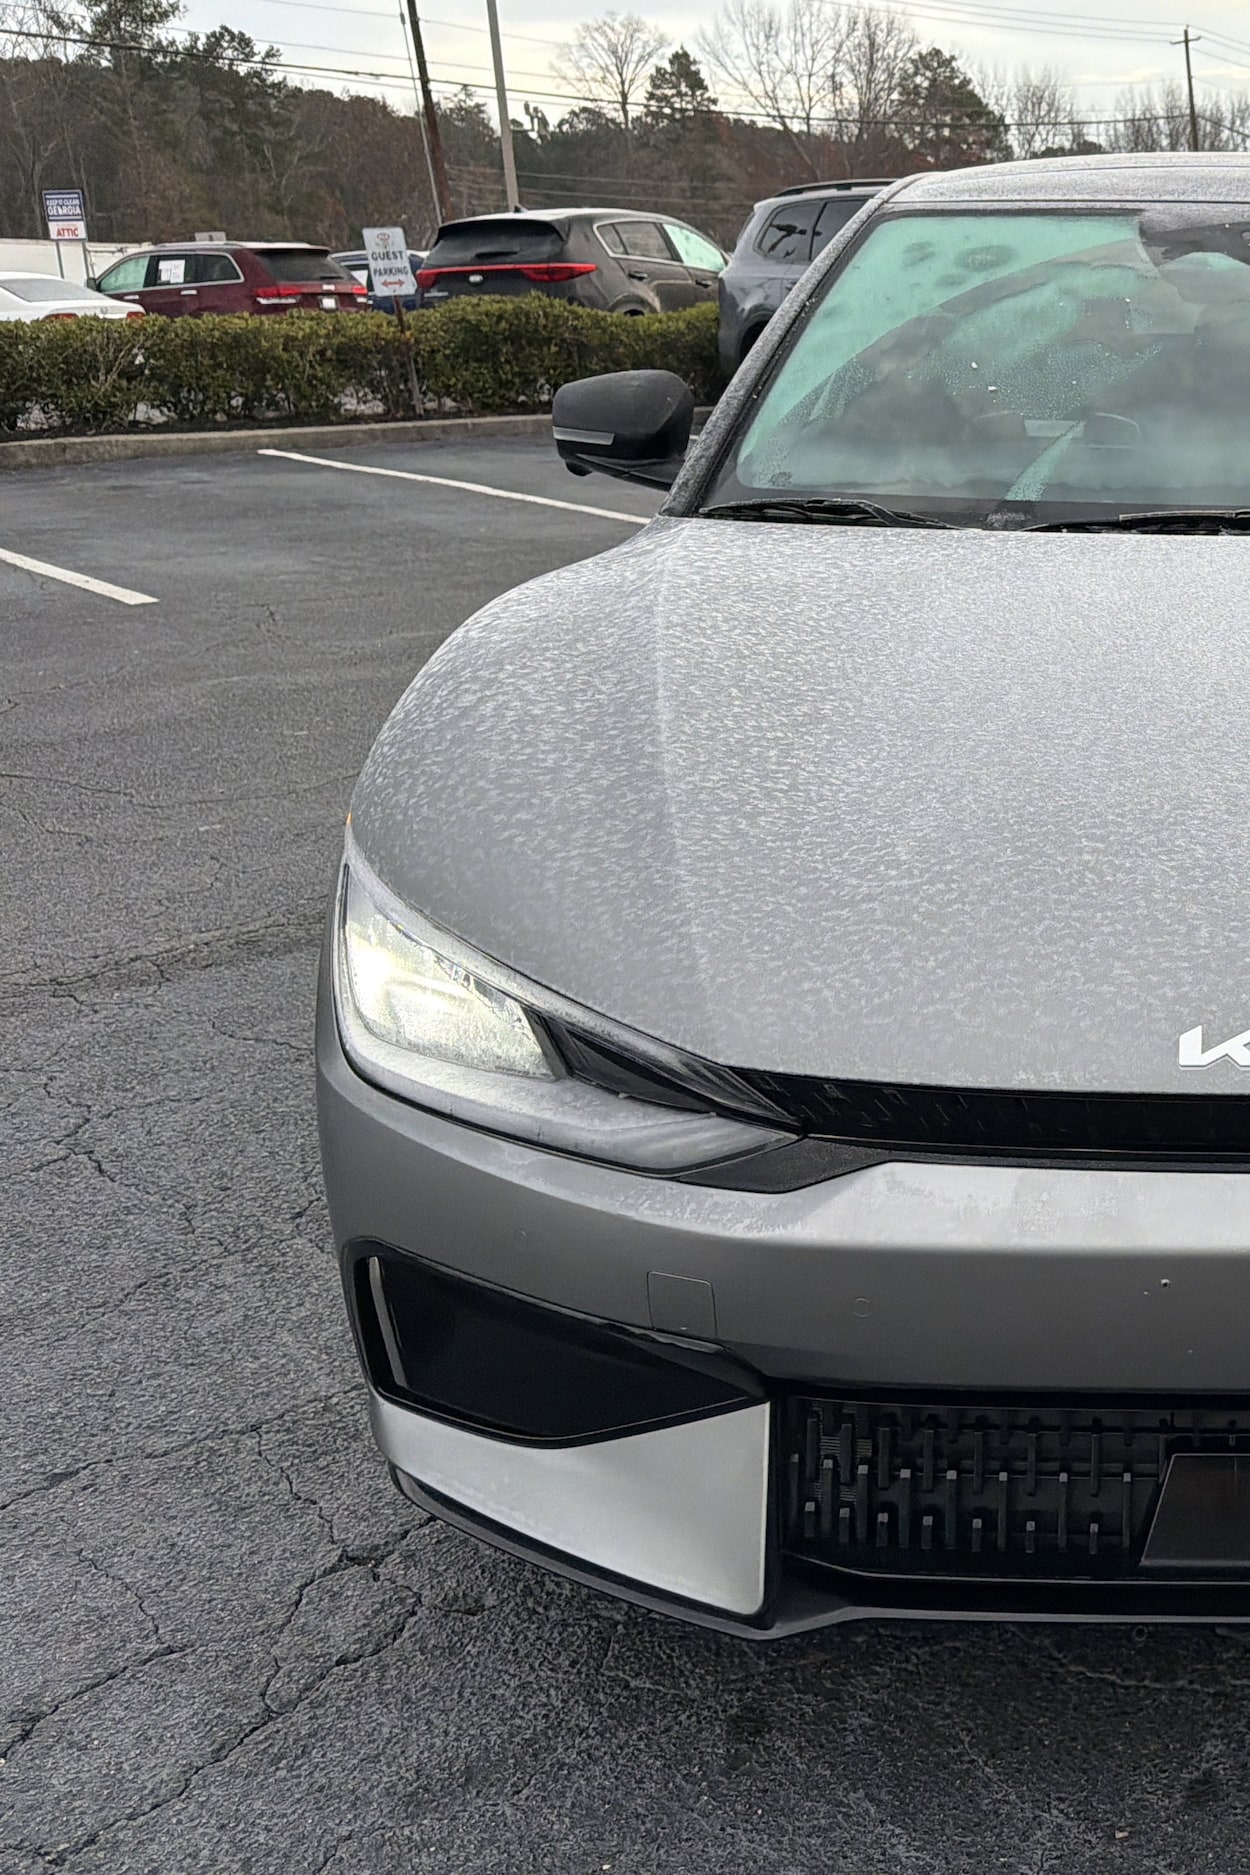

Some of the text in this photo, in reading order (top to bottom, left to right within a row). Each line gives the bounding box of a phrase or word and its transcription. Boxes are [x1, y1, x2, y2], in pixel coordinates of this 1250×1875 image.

[57, 228, 79, 237] ATTIC
[371, 250, 404, 260] GUEST
[373, 265, 409, 277] PARKING
